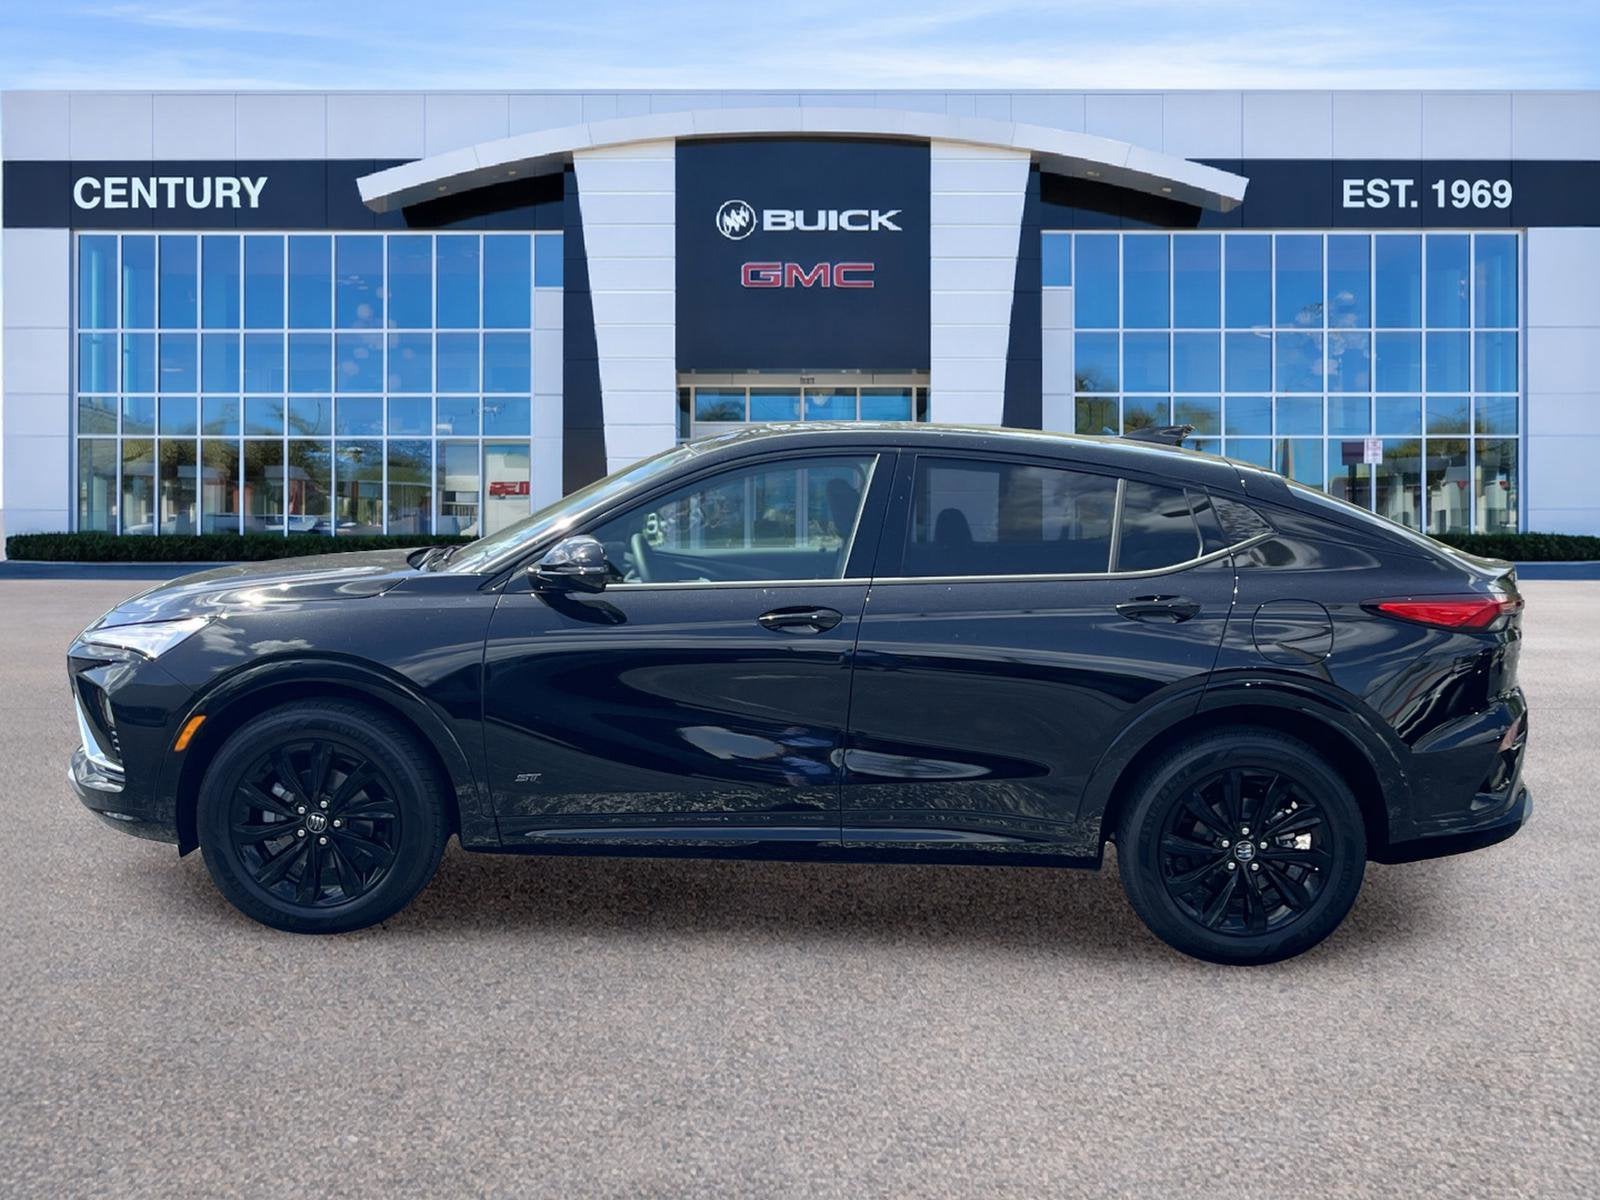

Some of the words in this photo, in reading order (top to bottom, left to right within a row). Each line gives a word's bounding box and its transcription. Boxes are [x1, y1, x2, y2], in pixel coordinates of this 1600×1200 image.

[73, 177, 268, 209] CENTURY
[1343, 178, 1418, 208] EST.
[1431, 179, 1513, 209] 1969
[763, 209, 902, 231] BUICK
[741, 262, 875, 288] GMC
